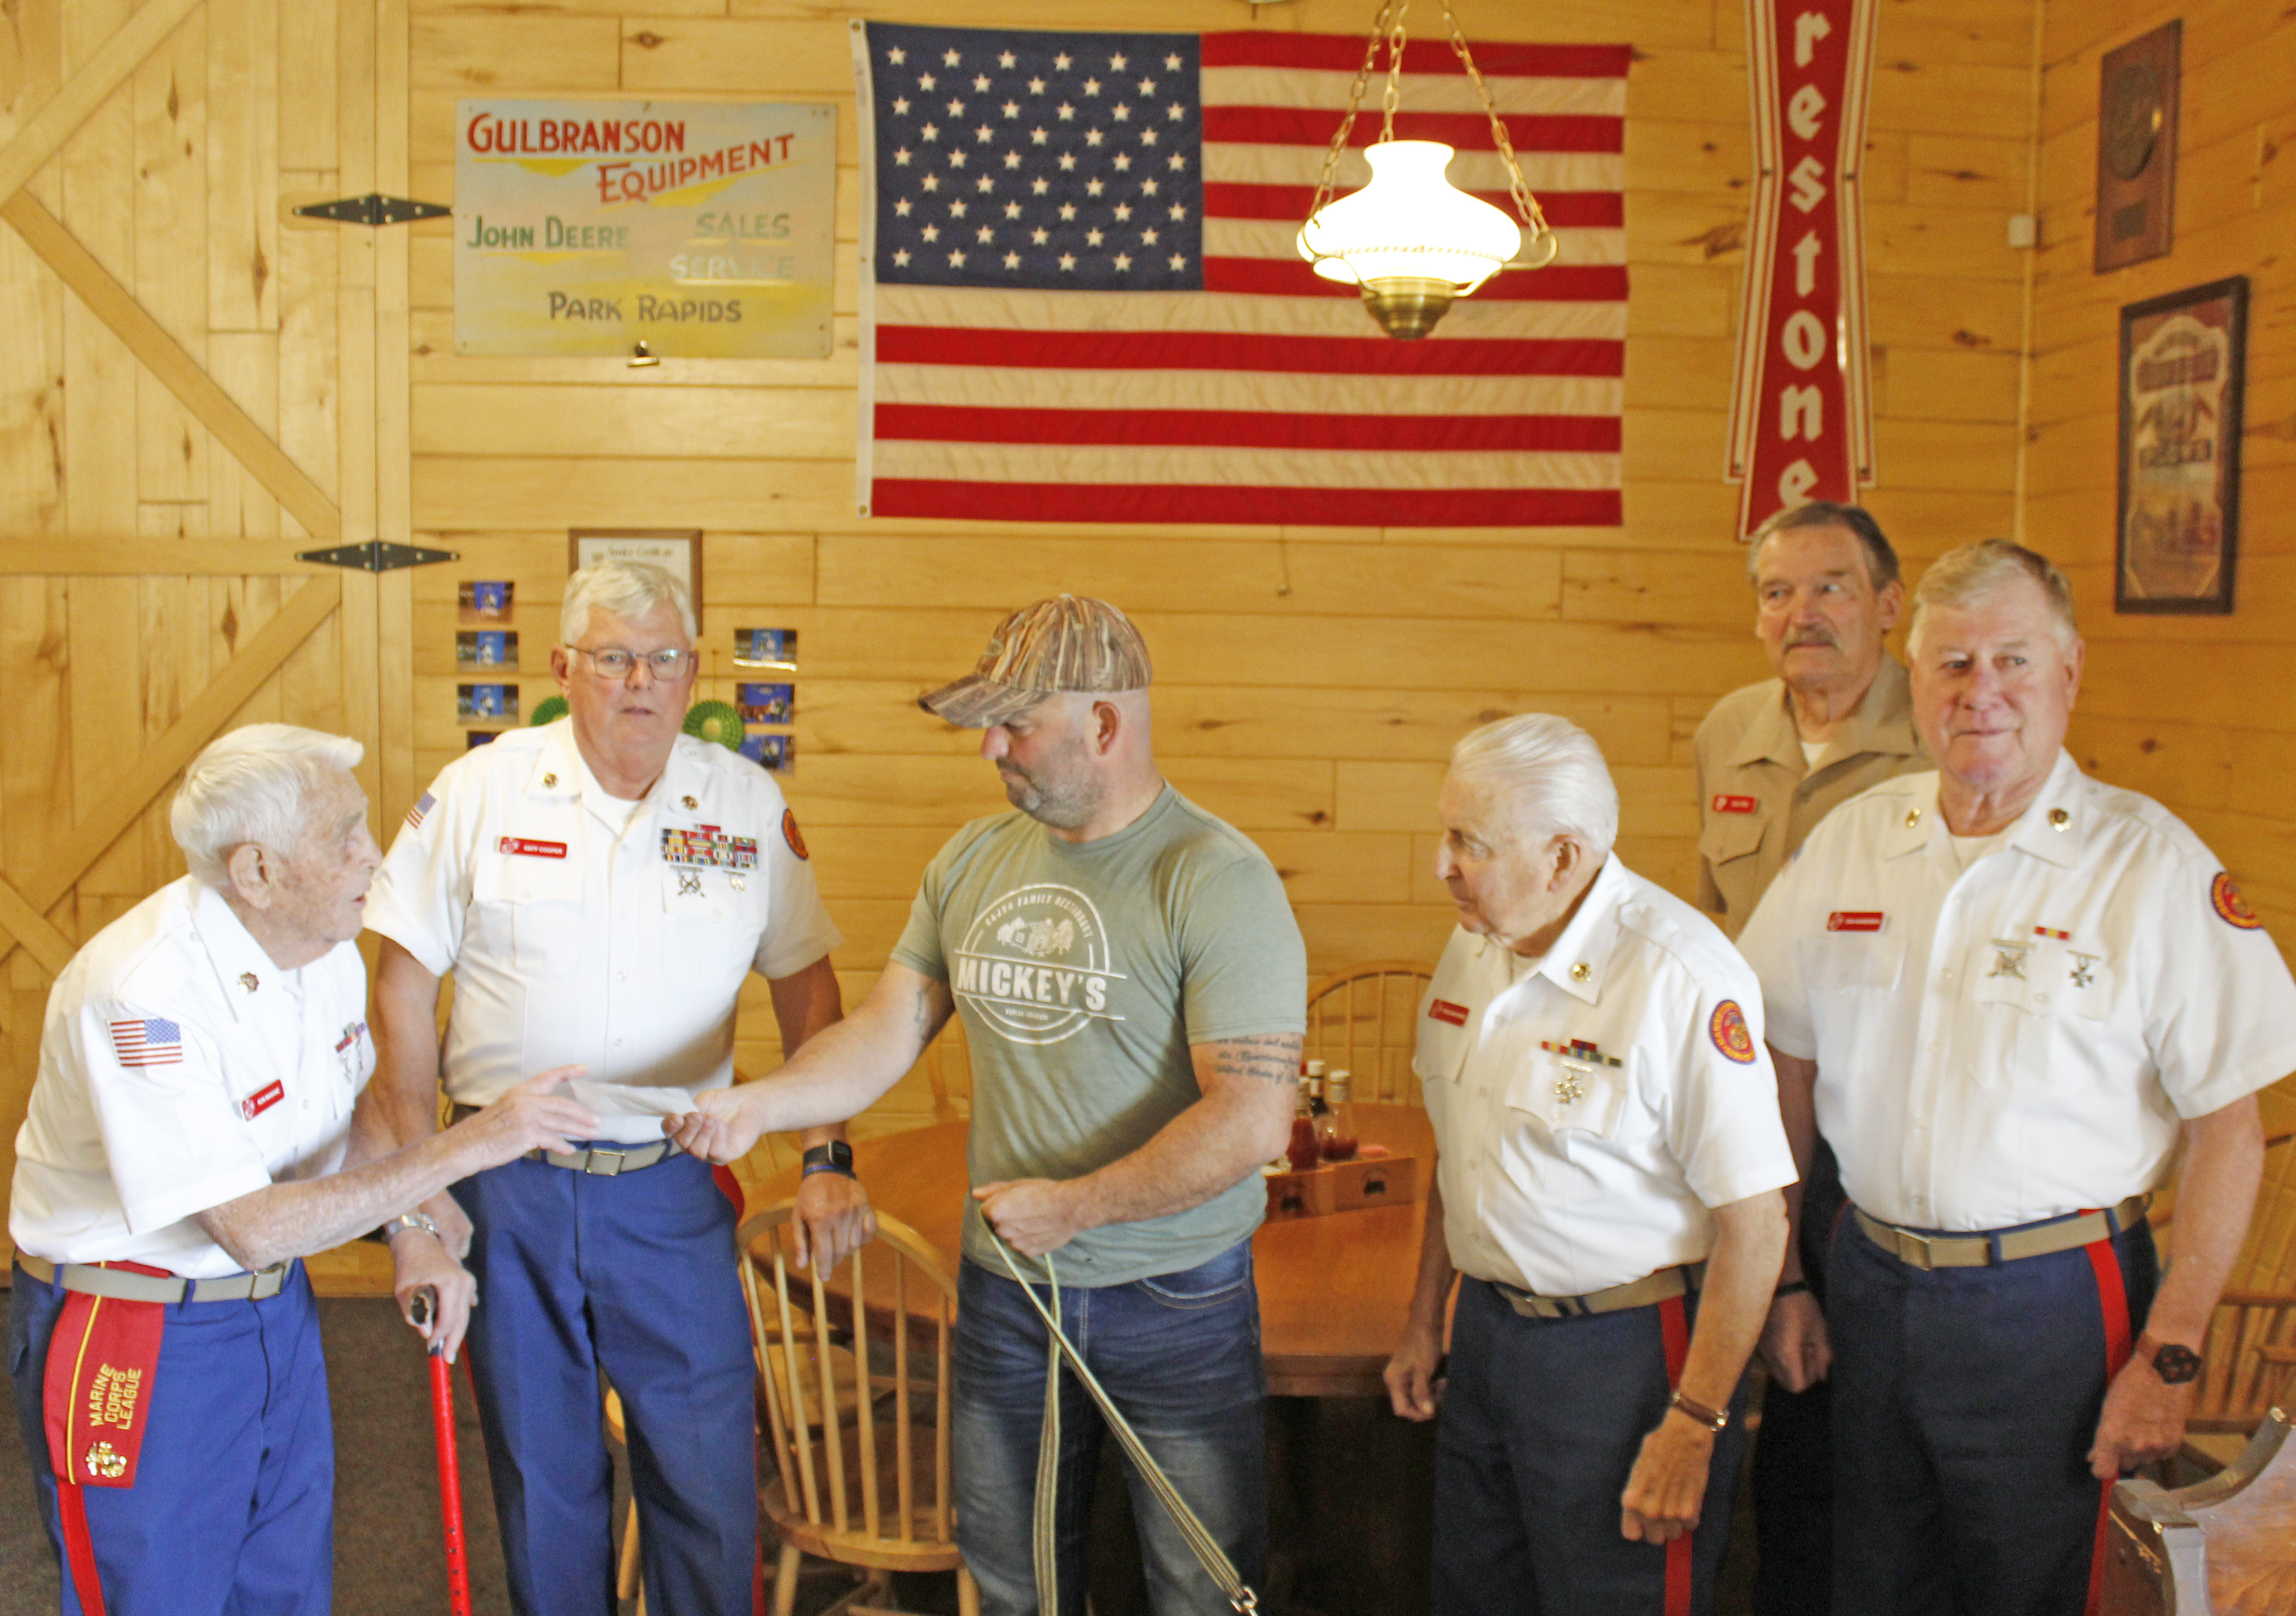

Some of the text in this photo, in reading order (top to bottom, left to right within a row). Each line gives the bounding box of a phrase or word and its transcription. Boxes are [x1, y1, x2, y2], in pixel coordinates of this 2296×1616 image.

[466, 113, 685, 153] GULBRANSON
[596, 133, 795, 204] EQUIPMENT
[467, 215, 629, 249] JOHN DEERE
[694, 212, 791, 239] SALES
[669, 254, 795, 279] SERVICE
[548, 291, 742, 323] PARK RAPIDS
[1017, 894, 1053, 907] FAMILY
[958, 957, 1106, 1011] MICKEY'S
[89, 1362, 115, 1427] MARINE
[104, 1371, 127, 1423] CORPS
[116, 1368, 142, 1430] LEAGUE
